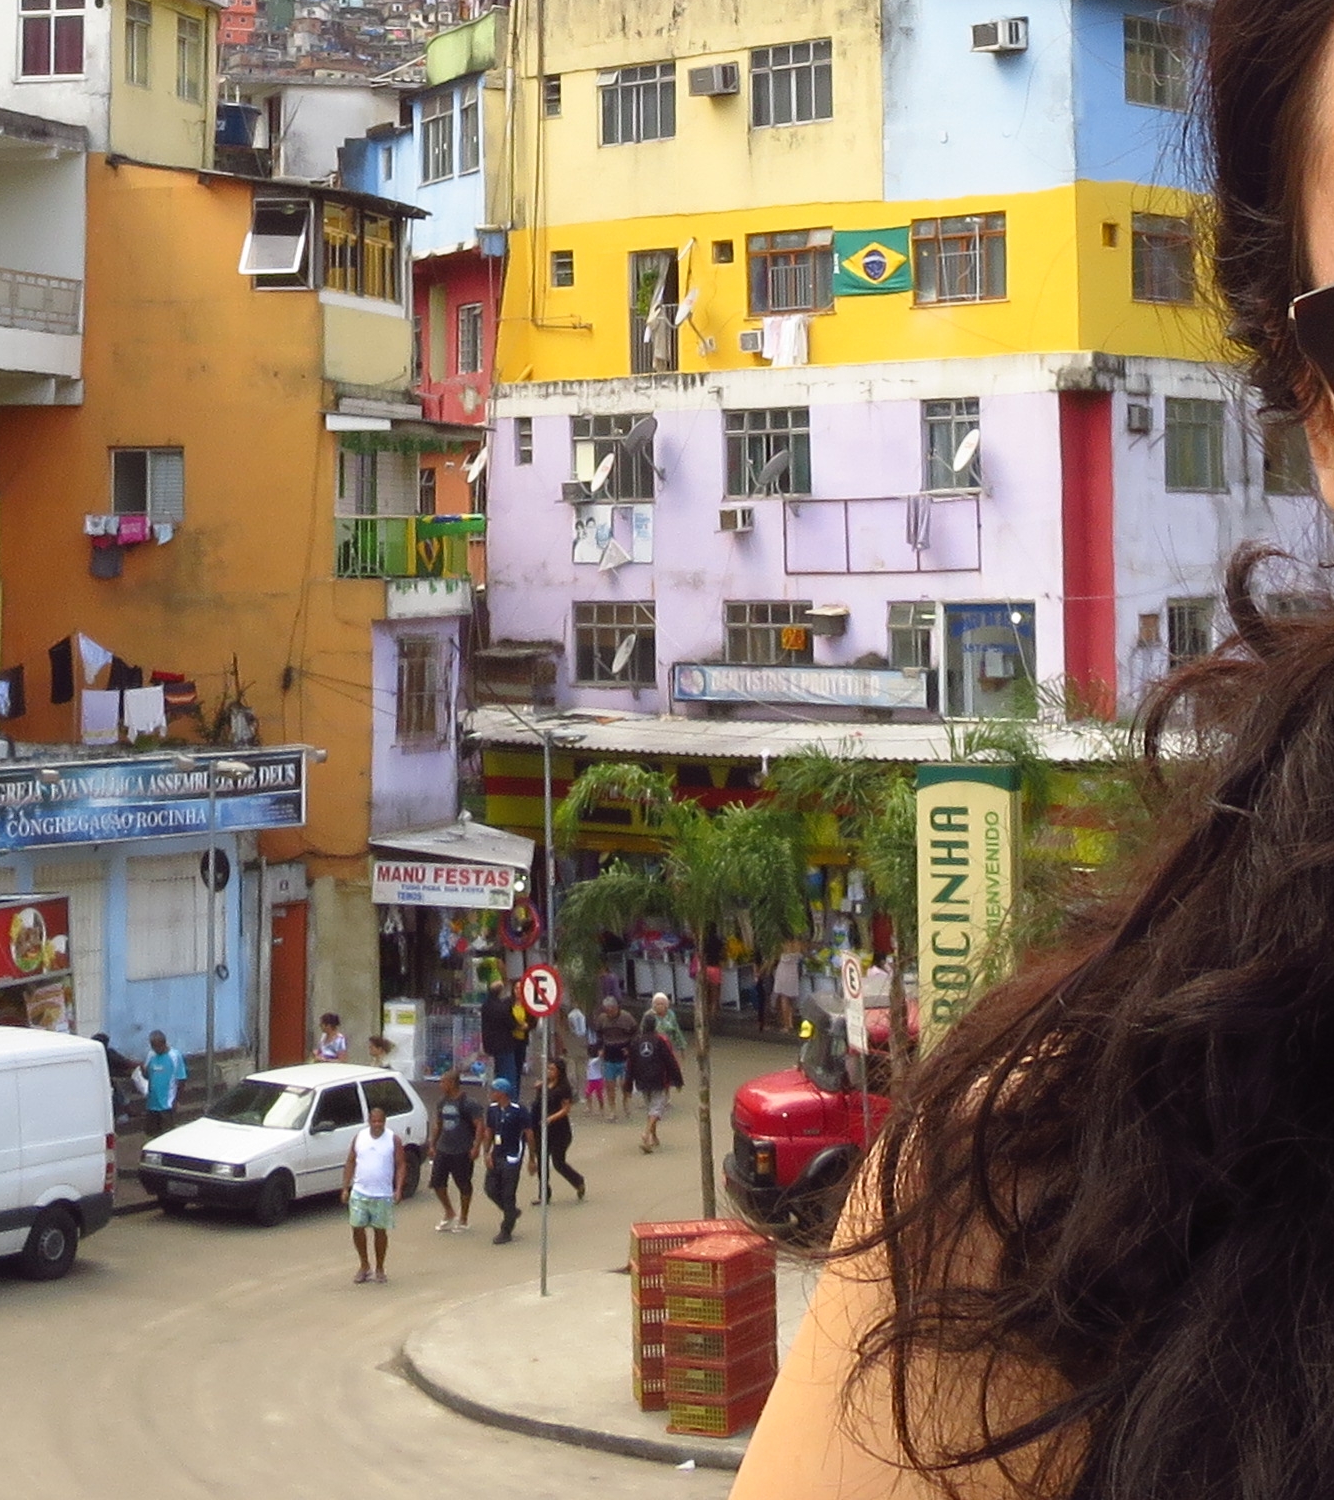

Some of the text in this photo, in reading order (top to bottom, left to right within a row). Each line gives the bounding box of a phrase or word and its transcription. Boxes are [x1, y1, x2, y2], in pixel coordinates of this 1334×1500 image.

[259, 763, 296, 788] DEUS
[136, 809, 207, 829] ROCINHA
[434, 867, 510, 887] FESTAS
[930, 806, 970, 1023] ROCINHA
[533, 976, 548, 1005] E
